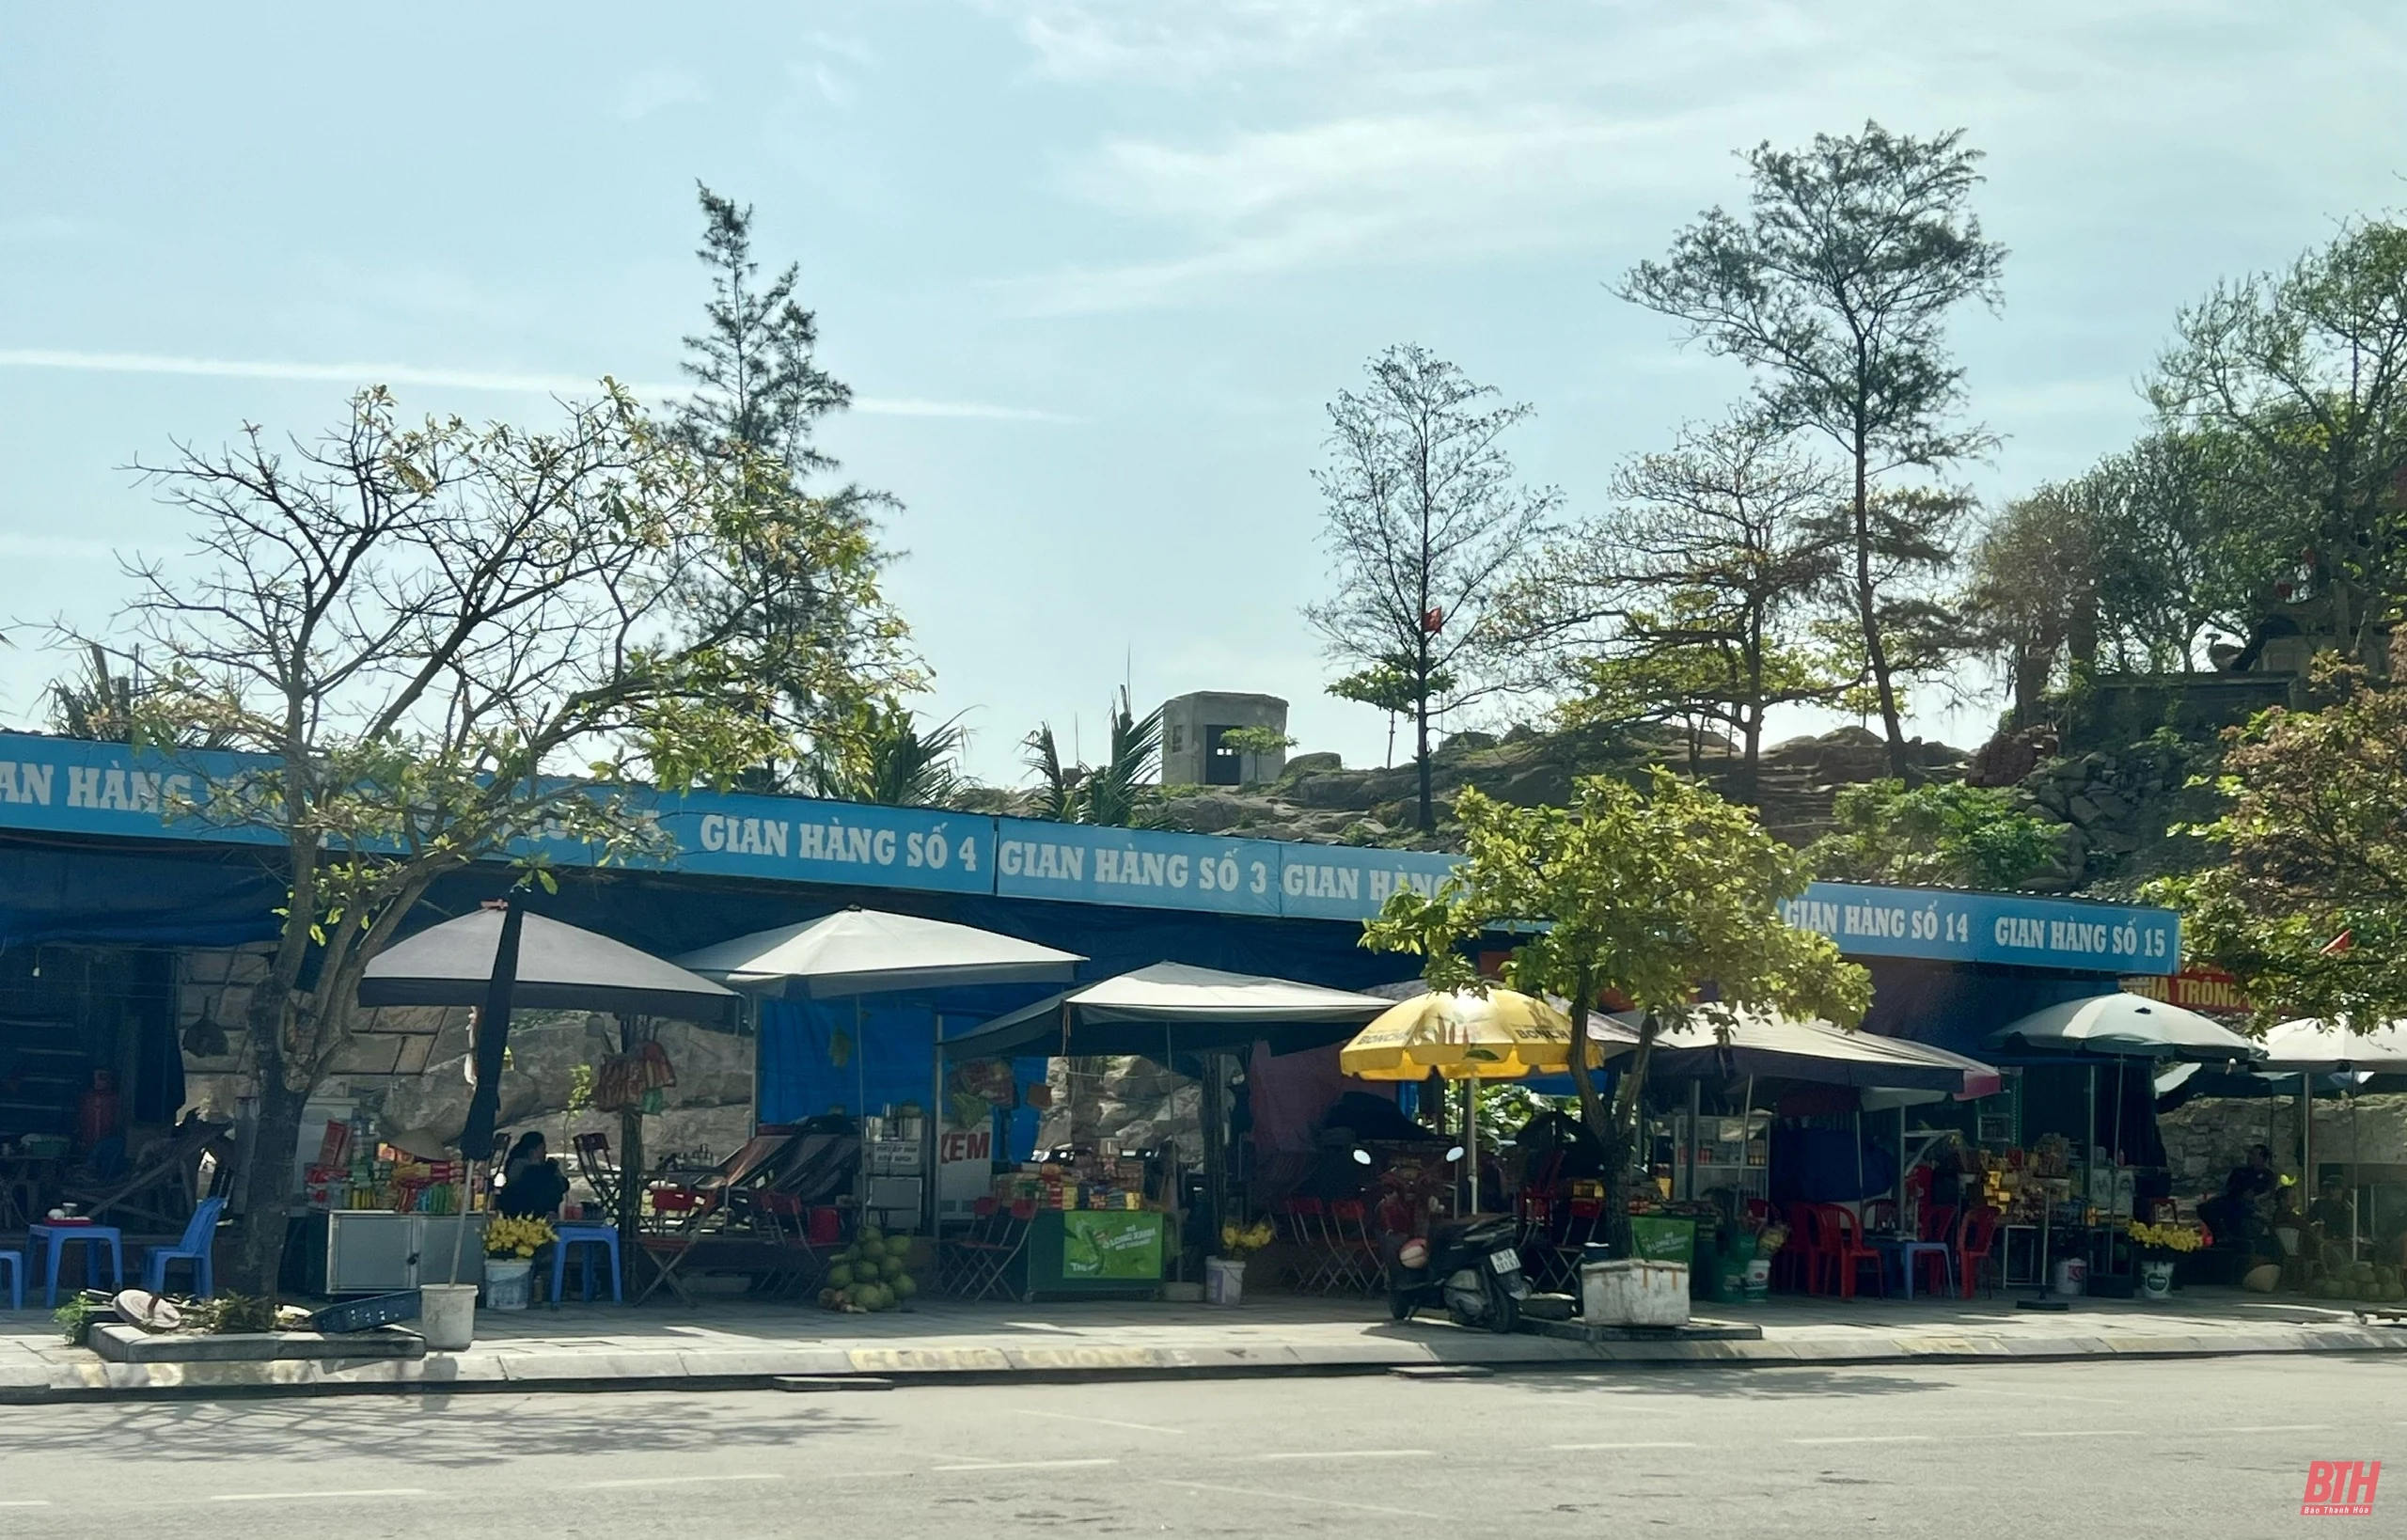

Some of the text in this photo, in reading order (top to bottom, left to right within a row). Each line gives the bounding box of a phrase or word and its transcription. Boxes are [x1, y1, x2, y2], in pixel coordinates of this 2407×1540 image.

[700, 814, 788, 857] GIAN
[799, 817, 895, 866] HÀNG
[906, 822, 948, 870] SỐ
[958, 836, 977, 872] 4
[999, 840, 1266, 894] GIAN HÀNG SỐ 3
[1282, 864, 1360, 901] GIAN
[1785, 899, 1968, 942] GIAN HÀNG SỐ 14
[1994, 916, 2165, 957] GIAN HÀNG SỐ 15
